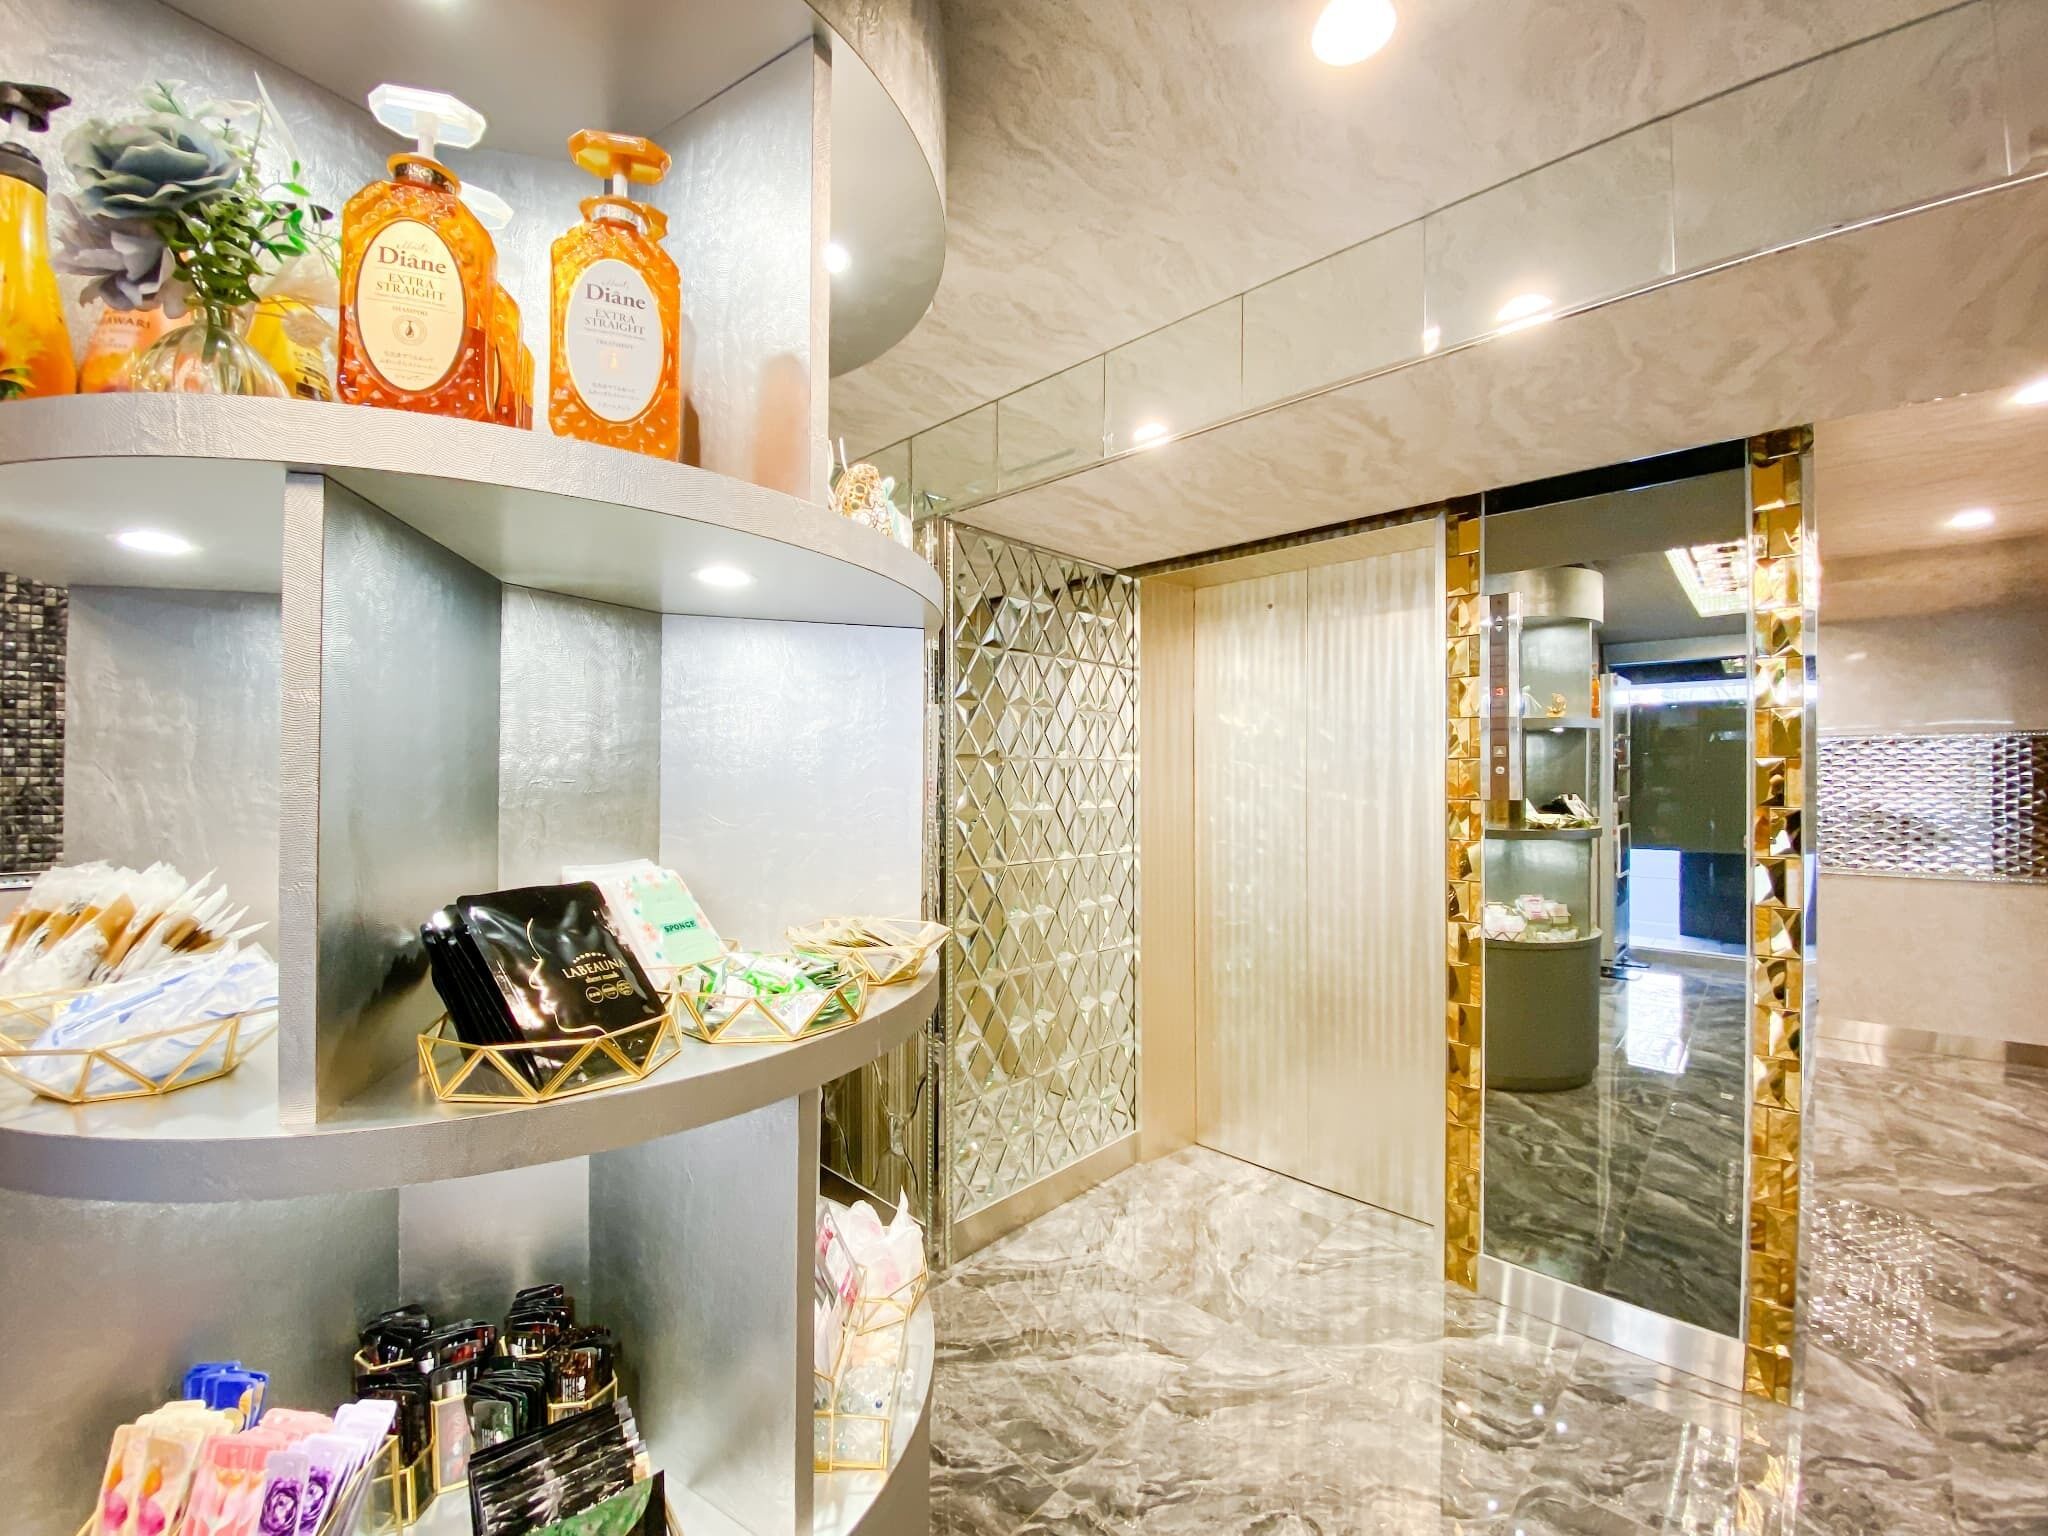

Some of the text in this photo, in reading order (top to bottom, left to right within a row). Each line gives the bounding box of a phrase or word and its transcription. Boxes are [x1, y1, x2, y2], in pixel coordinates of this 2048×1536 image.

[388, 272, 434, 290] EXTRA
[376, 280, 446, 302] STRAIGHT
[584, 316, 646, 336] STRAIGHT
[595, 308, 636, 325] EXTRA
[664, 920, 696, 933] SPONGE
[562, 958, 626, 979] LABEAUNA
